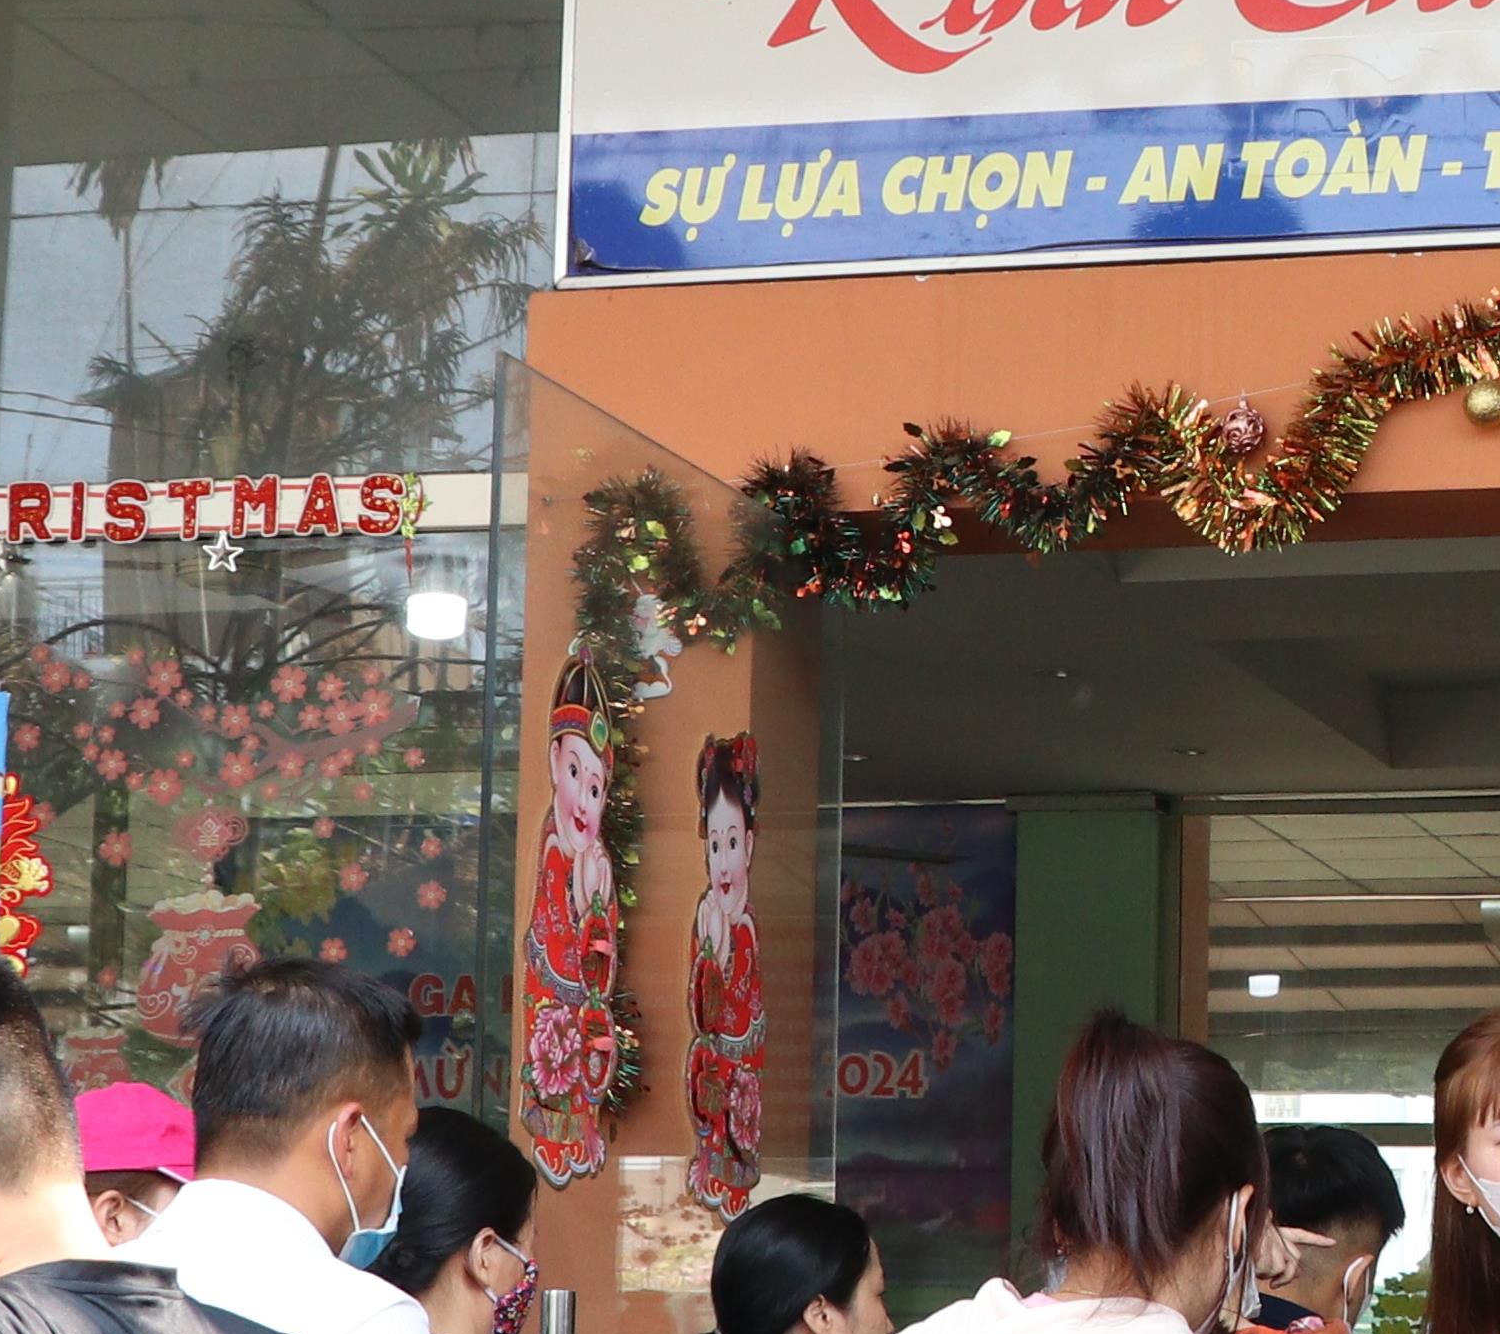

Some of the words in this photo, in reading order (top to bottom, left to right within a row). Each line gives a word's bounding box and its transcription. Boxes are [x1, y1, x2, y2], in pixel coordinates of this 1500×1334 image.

[639, 153, 736, 231] SỰ
[739, 148, 861, 237] LỰA
[882, 151, 1071, 228] CHỌN
[1121, 142, 1224, 203] AN
[1235, 120, 1426, 198] TOÀN
[408, 973, 477, 1016] GA
